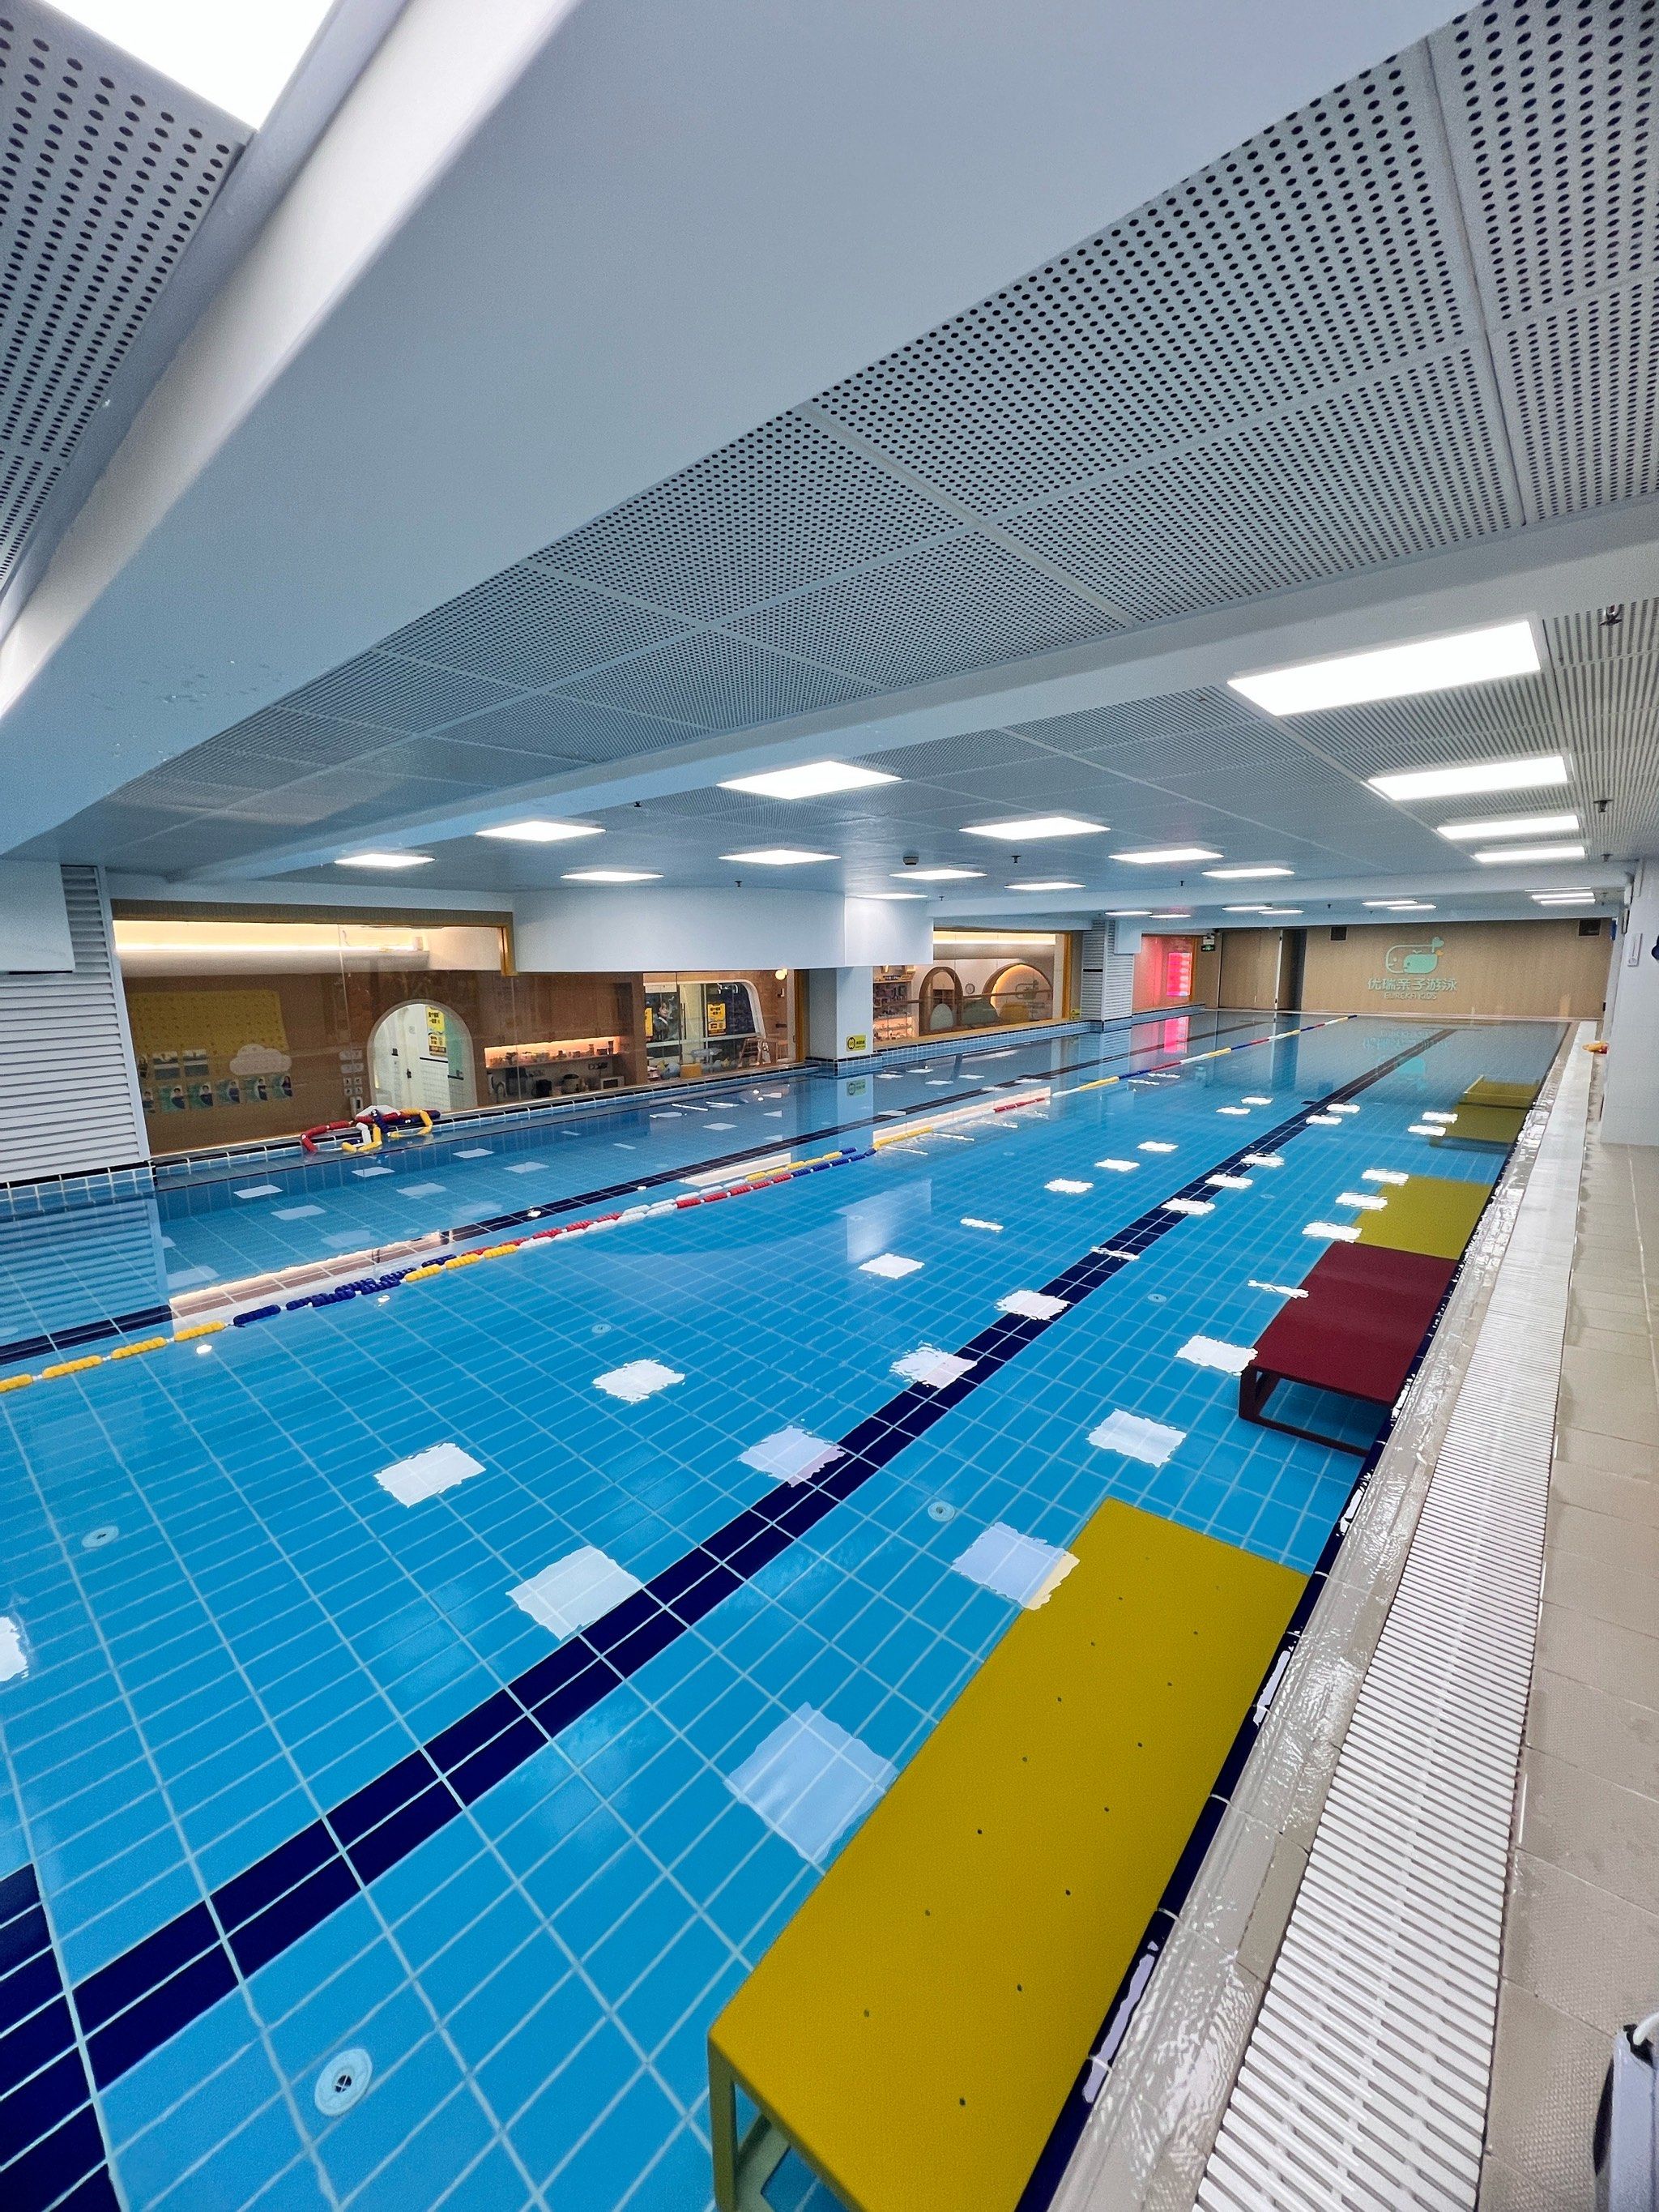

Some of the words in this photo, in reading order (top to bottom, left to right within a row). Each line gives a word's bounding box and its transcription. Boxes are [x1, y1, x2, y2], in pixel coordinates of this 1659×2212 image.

[1367, 977, 1457, 991] 优瑞亲子游泳
